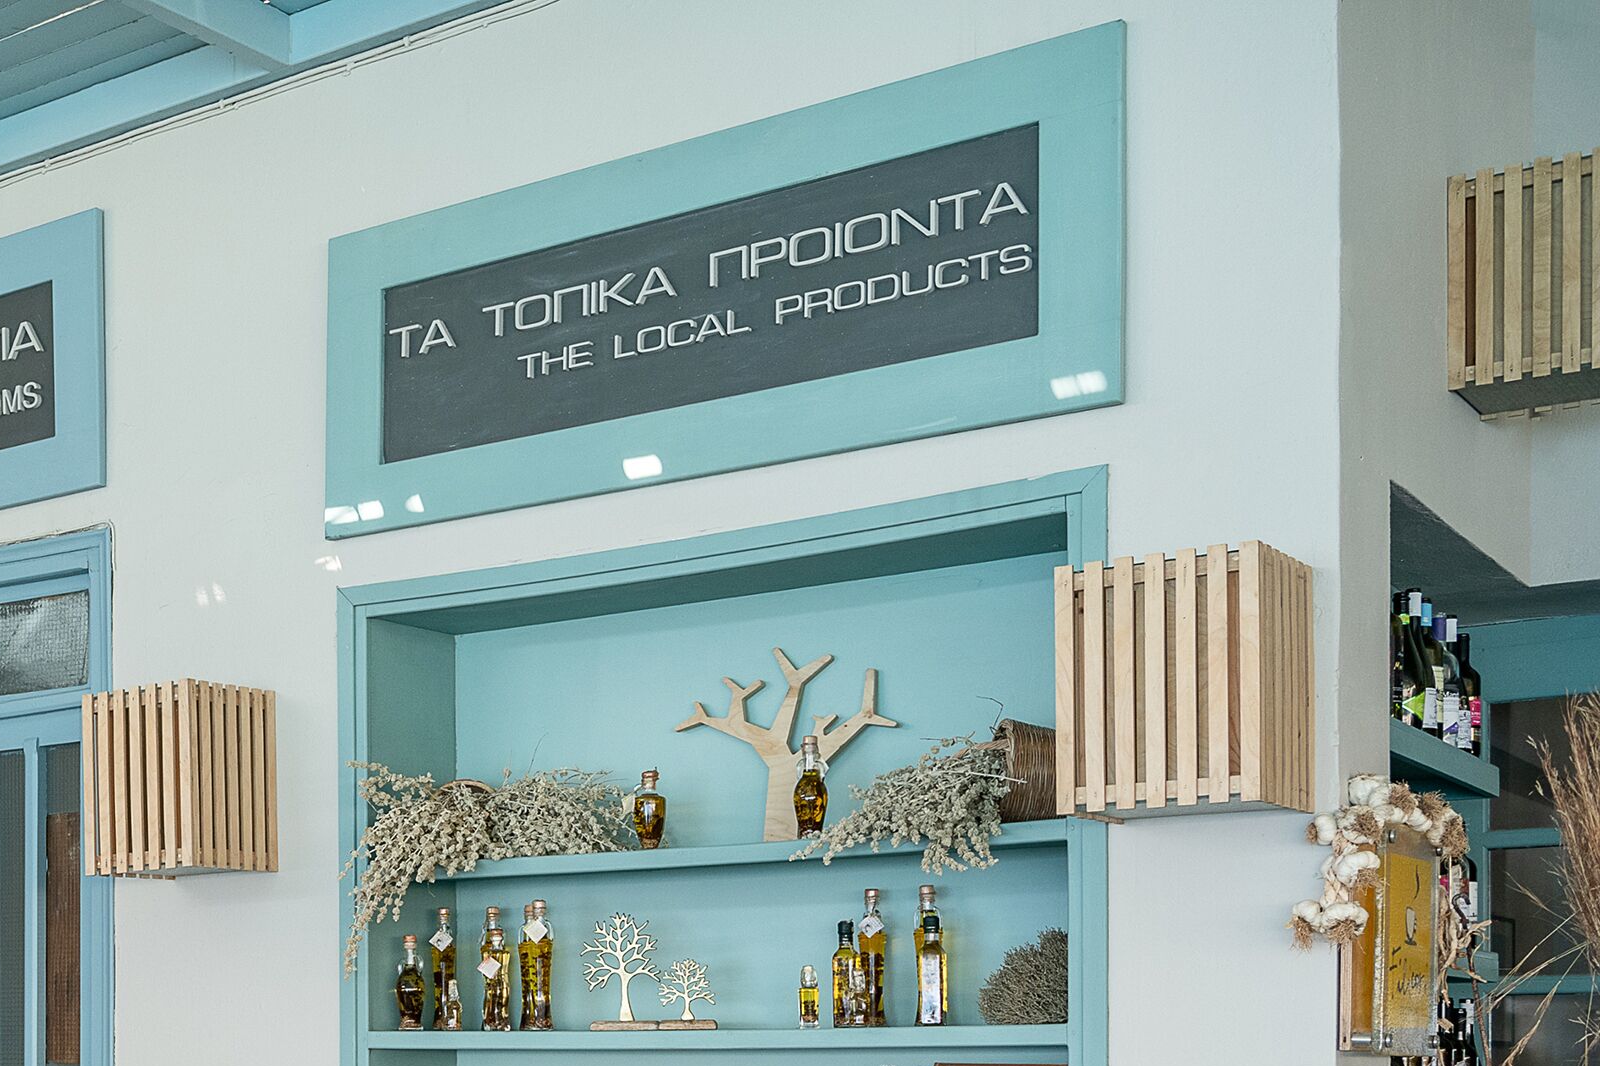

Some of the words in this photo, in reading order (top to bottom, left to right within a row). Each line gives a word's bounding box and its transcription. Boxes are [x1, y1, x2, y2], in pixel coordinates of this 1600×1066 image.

[389, 318, 456, 358] ΤΑ
[482, 267, 677, 337] ΤΟΠΙΚΑ
[709, 182, 1029, 288] ΠΡΟΙΟΝΤΑ
[517, 340, 594, 378] THE
[614, 310, 752, 359] LOCAL
[774, 244, 1032, 325] PRODUCTS
